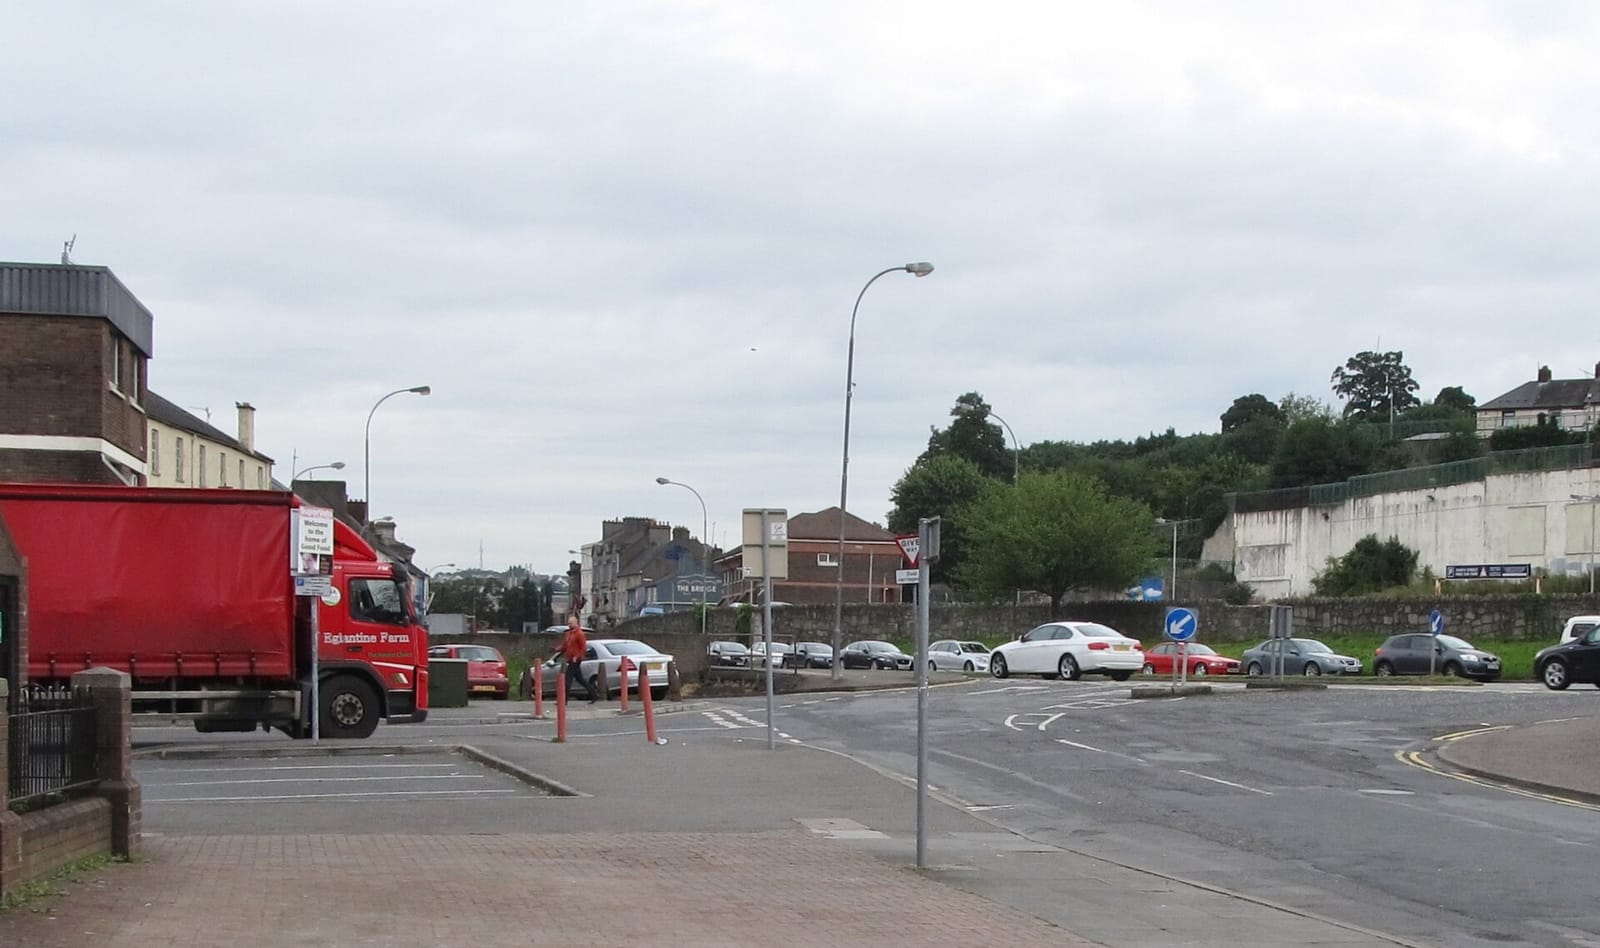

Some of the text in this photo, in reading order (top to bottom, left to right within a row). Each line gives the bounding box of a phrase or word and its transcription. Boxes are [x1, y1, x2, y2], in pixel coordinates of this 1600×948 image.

[304, 520, 328, 528] Welcome
[305, 535, 320, 543] home
[901, 539, 920, 547] GIVE
[301, 543, 316, 551] Good
[323, 632, 410, 645] Eglantine Farm
